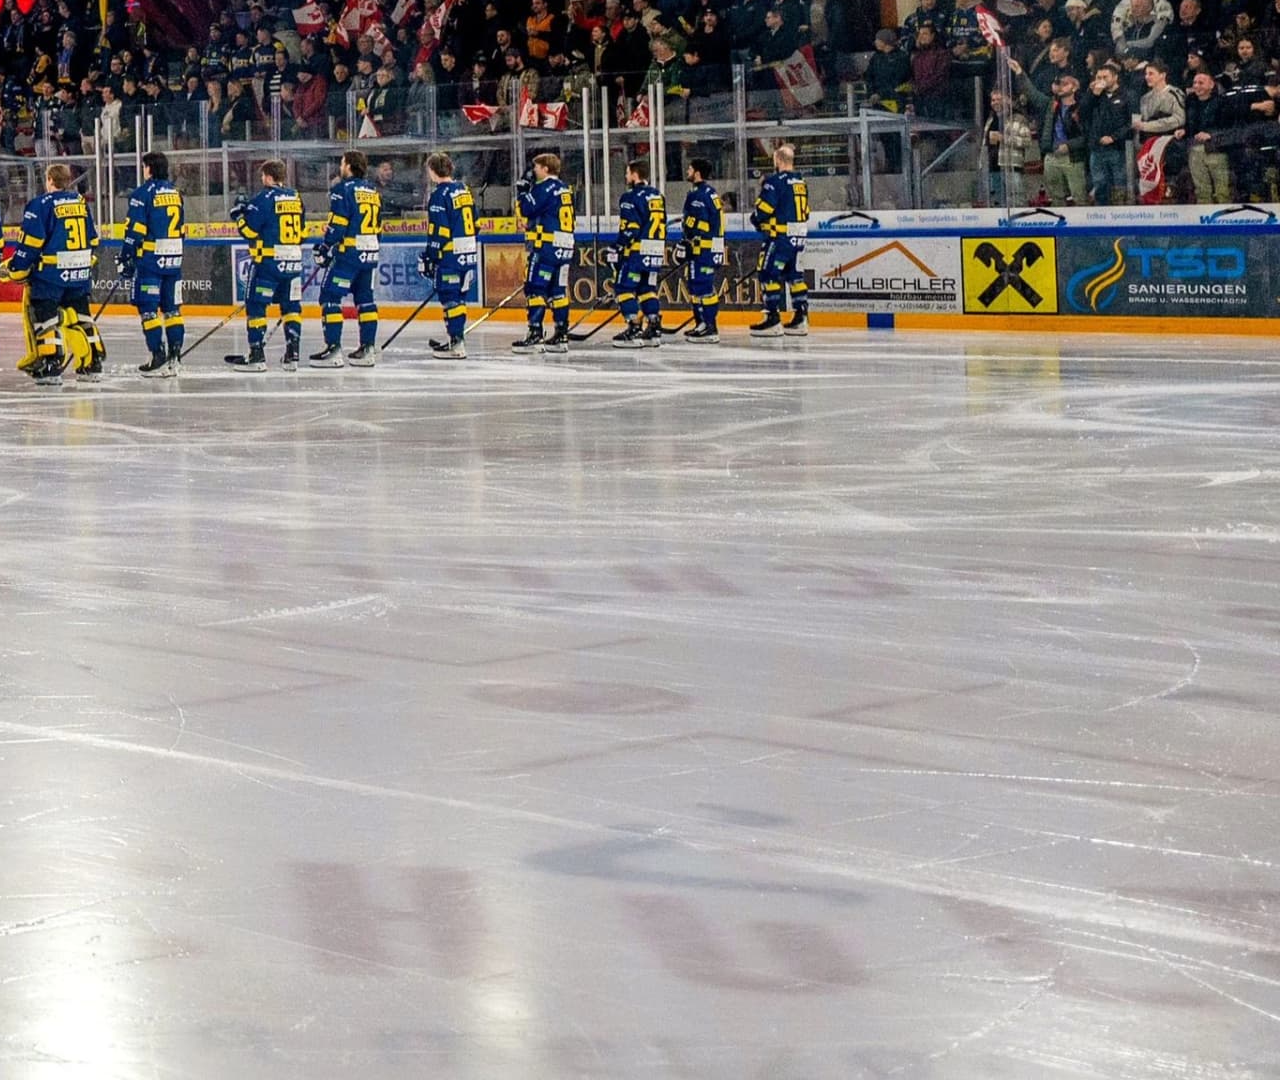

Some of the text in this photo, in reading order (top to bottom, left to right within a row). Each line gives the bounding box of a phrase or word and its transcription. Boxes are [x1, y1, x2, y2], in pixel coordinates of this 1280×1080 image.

[65, 217, 87, 250] 31
[279, 214, 301, 245] 69
[1127, 247, 1246, 278] TSD
[1128, 284, 1247, 295] SANIERUNGEN
[1129, 296, 1157, 304] BRAND
[1171, 296, 1247, 305] WASSERSCHÄDEN
